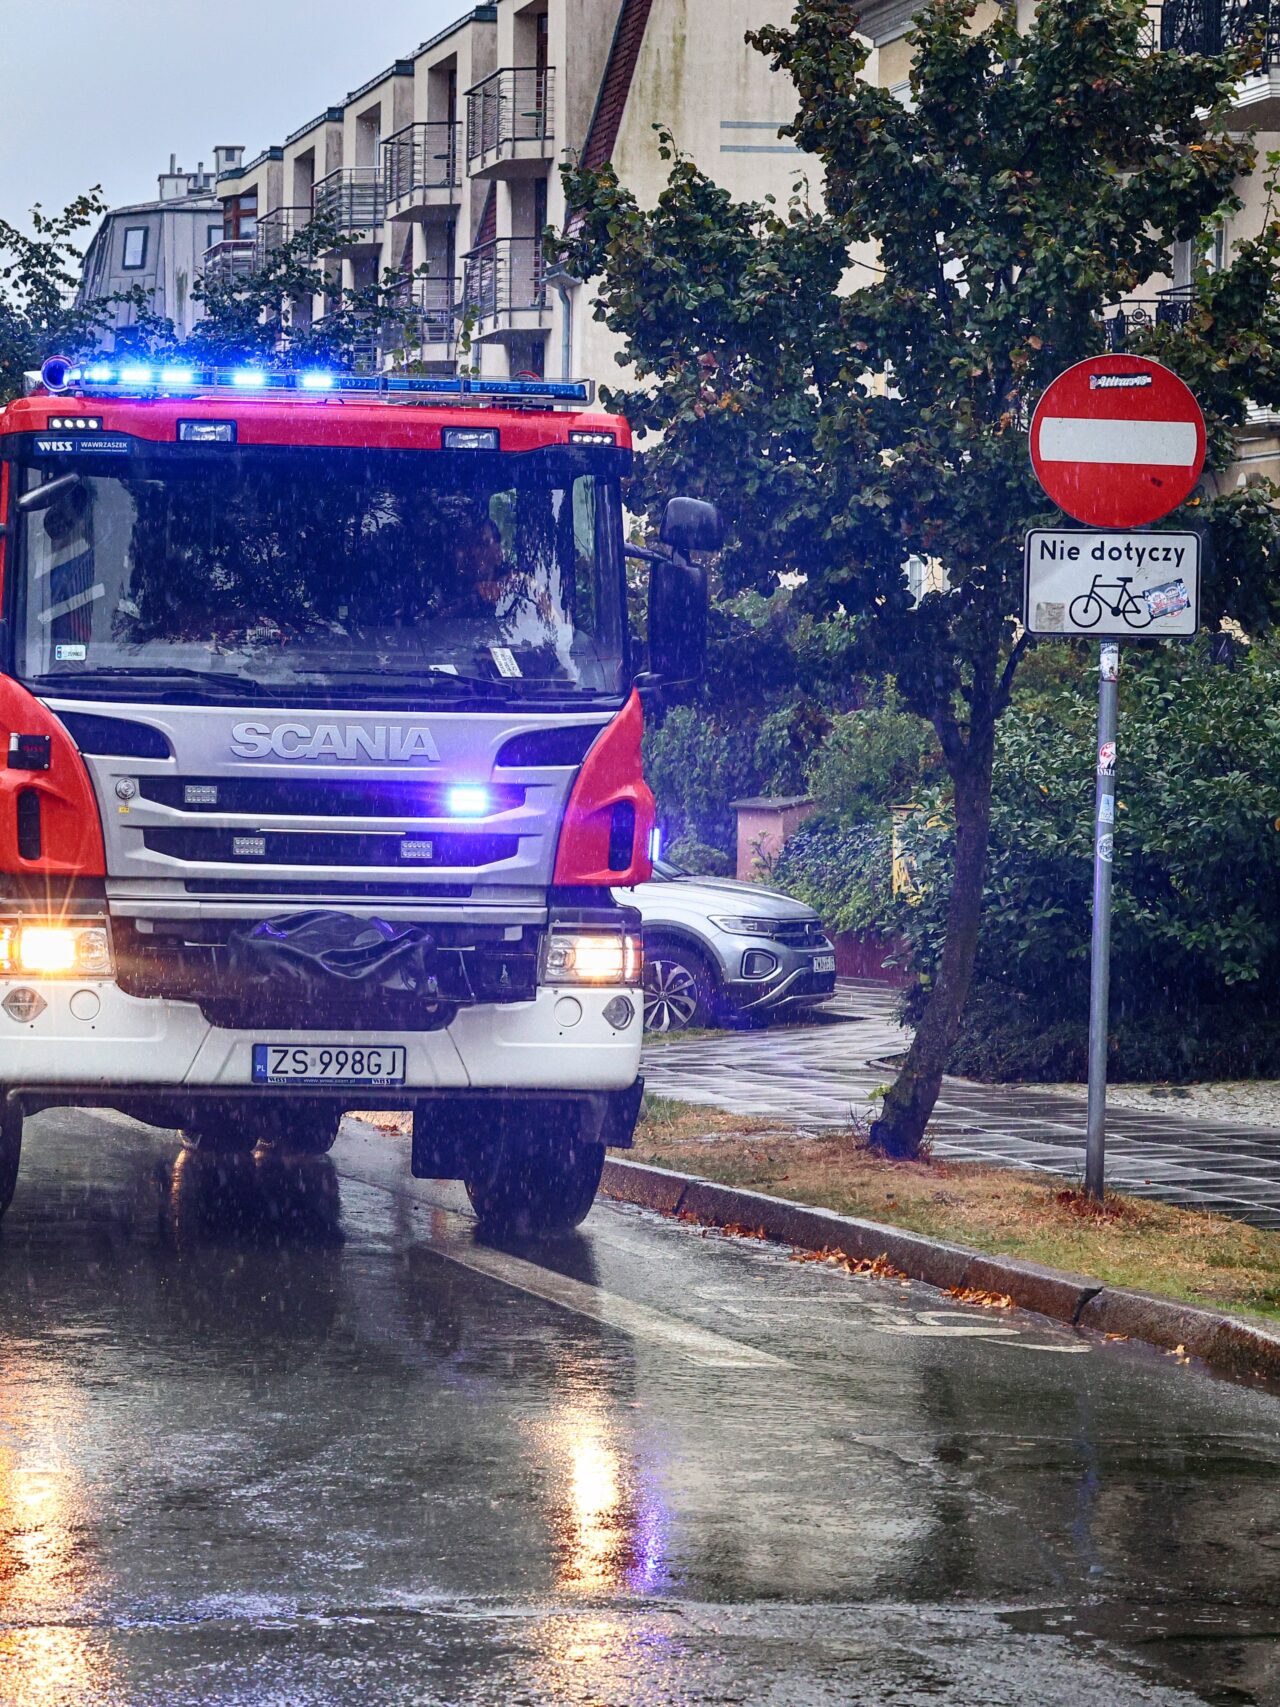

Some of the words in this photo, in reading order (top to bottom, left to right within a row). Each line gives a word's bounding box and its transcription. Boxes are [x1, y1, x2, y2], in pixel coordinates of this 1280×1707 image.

[37, 441, 72, 451] WISS
[1040, 540, 1080, 561] Nie
[1091, 541, 1186, 568] dotyczy
[230, 722, 441, 762] SCANIA
[256, 1064, 265, 1072] PL
[271, 1049, 308, 1075] ZS
[319, 1050, 396, 1076] 998GJ
